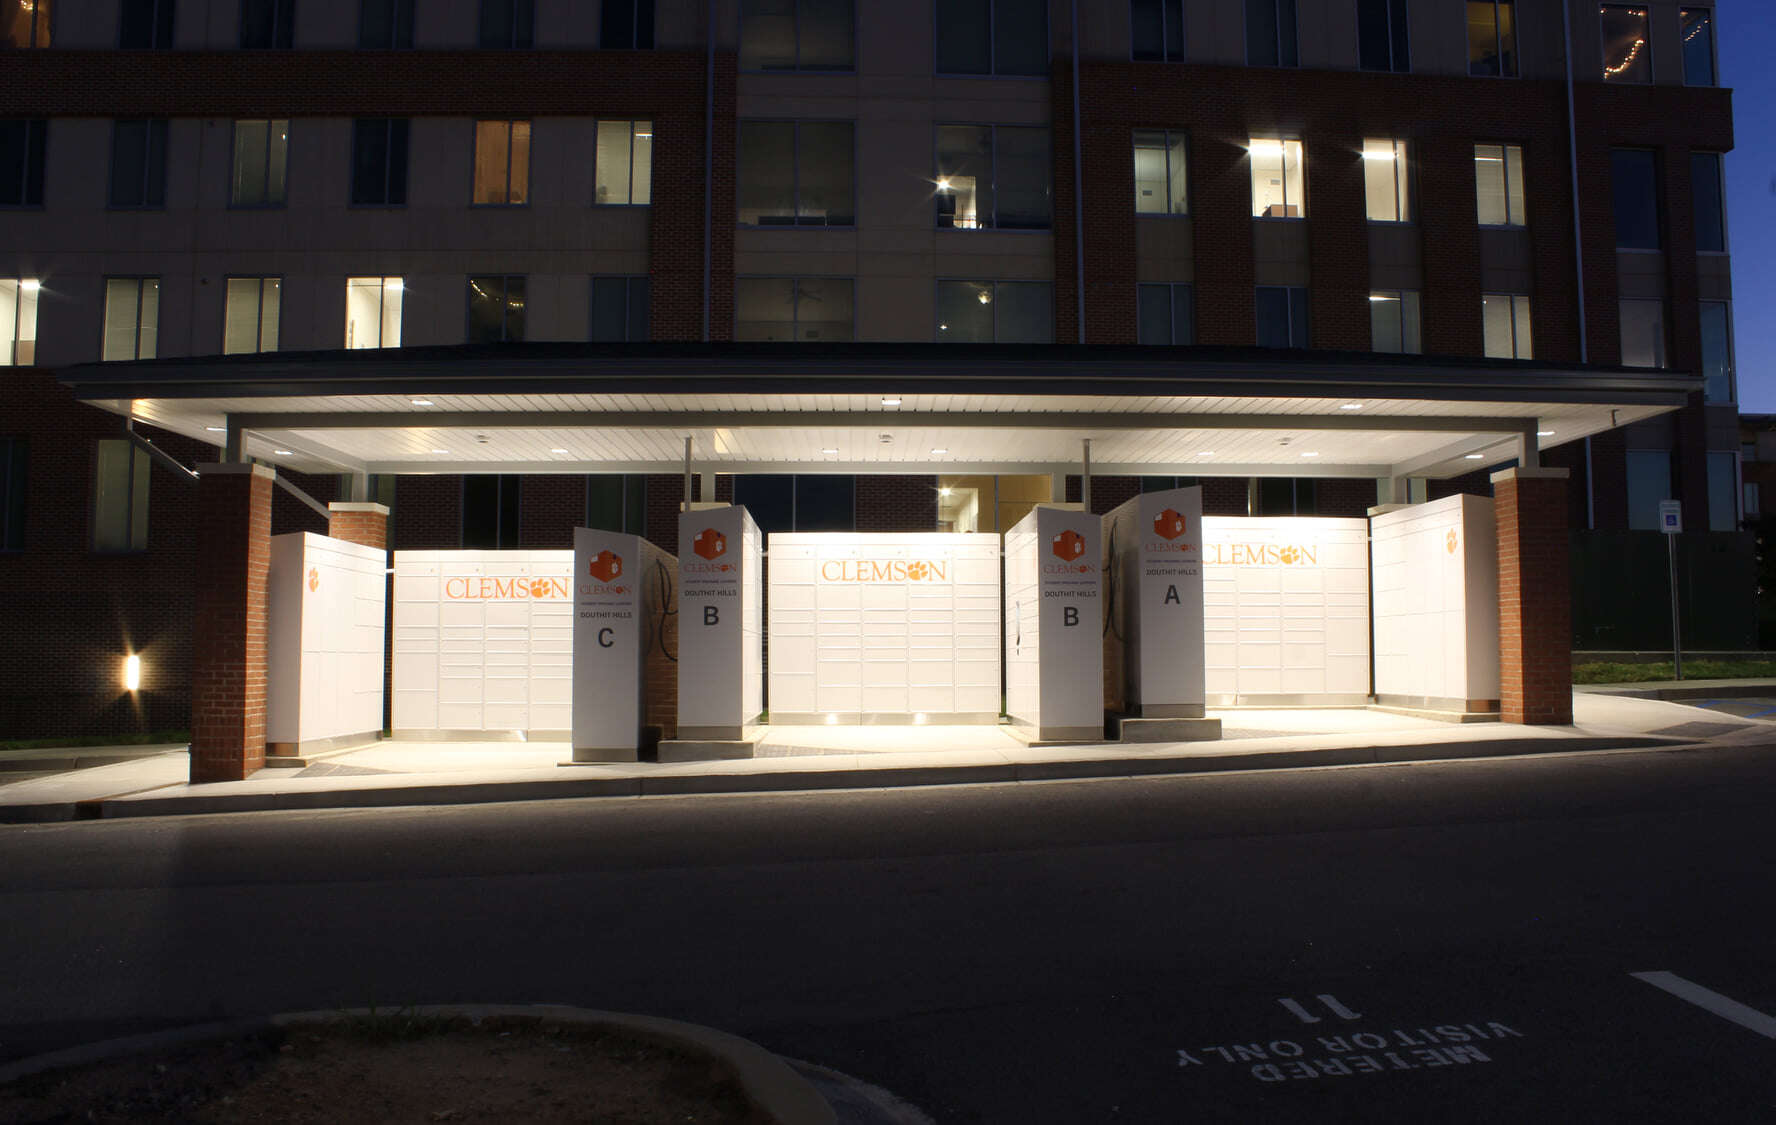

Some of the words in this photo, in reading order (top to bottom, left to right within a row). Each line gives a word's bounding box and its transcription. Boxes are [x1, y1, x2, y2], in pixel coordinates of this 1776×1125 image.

[1145, 568, 1177, 576] DOUTHIT
[1178, 568, 1198, 576] HILLS
[1044, 590, 1075, 598] DOUTHIT
[1076, 590, 1097, 598] HILLS
[1164, 584, 1181, 605] A
[580, 611, 611, 619] DOUTHIT
[612, 611, 633, 619] HILLS
[703, 606, 719, 626] B
[1063, 606, 1079, 627] B
[598, 628, 614, 648] C
[1274, 993, 1363, 1024] 11
[1316, 1021, 1527, 1053] VISITOR
[1175, 1039, 1305, 1068] ONLY
[1250, 1044, 1493, 1082] METERED
